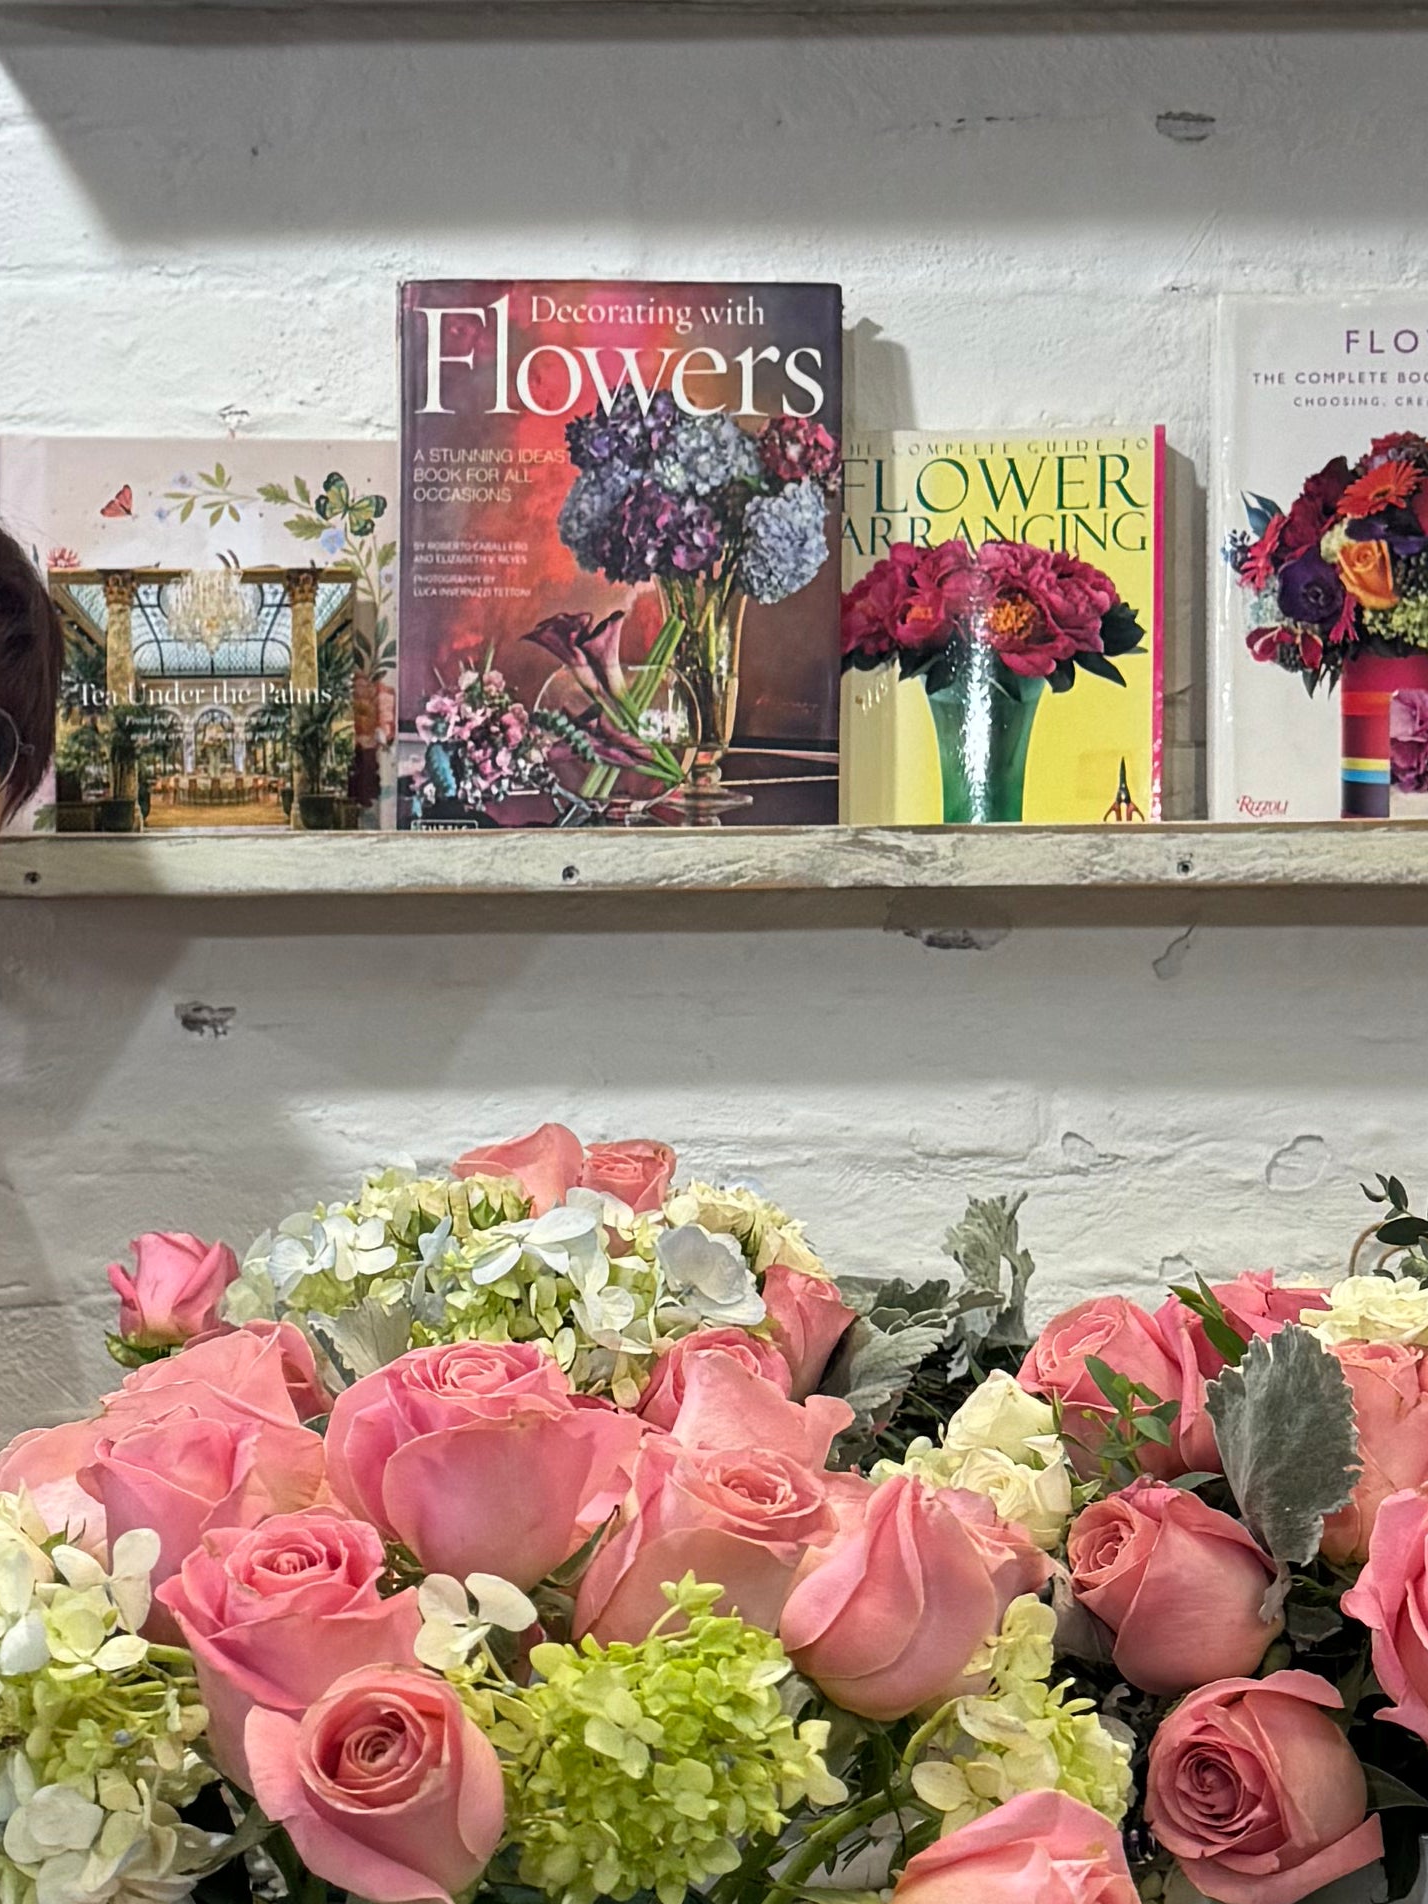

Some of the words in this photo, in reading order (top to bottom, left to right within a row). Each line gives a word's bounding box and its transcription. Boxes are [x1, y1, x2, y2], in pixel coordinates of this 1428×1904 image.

[531, 295, 693, 336] Decorating
[699, 295, 766, 326] with
[414, 293, 825, 418] Flowers
[1252, 371, 1286, 385] THE
[1294, 371, 1389, 385] COMPLETE
[891, 441, 1011, 457] COMPLETE
[1026, 439, 1105, 455] GUIDE
[1120, 437, 1149, 451] TO
[413, 448, 425, 462] A
[429, 448, 513, 464] STUNNING
[518, 448, 566, 464] IDEAS
[413, 467, 461, 483] BOOK
[466, 467, 500, 483] FOR
[504, 468, 533, 484] ALL
[841, 453, 1150, 514] FLOWER
[413, 487, 512, 504] OCCASIONS
[841, 510, 1148, 558] ARRANGING
[413, 541, 425, 551] BY
[427, 541, 471, 551] ROBERTO
[473, 541, 529, 551] CABALLERO
[413, 555, 433, 564] AND
[498, 555, 528, 564] REYES
[413, 587, 437, 597] LUCA
[78, 682, 118, 707] Tea
[128, 680, 206, 706] Under
[213, 679, 253, 705] the
[260, 679, 333, 705] Palms
